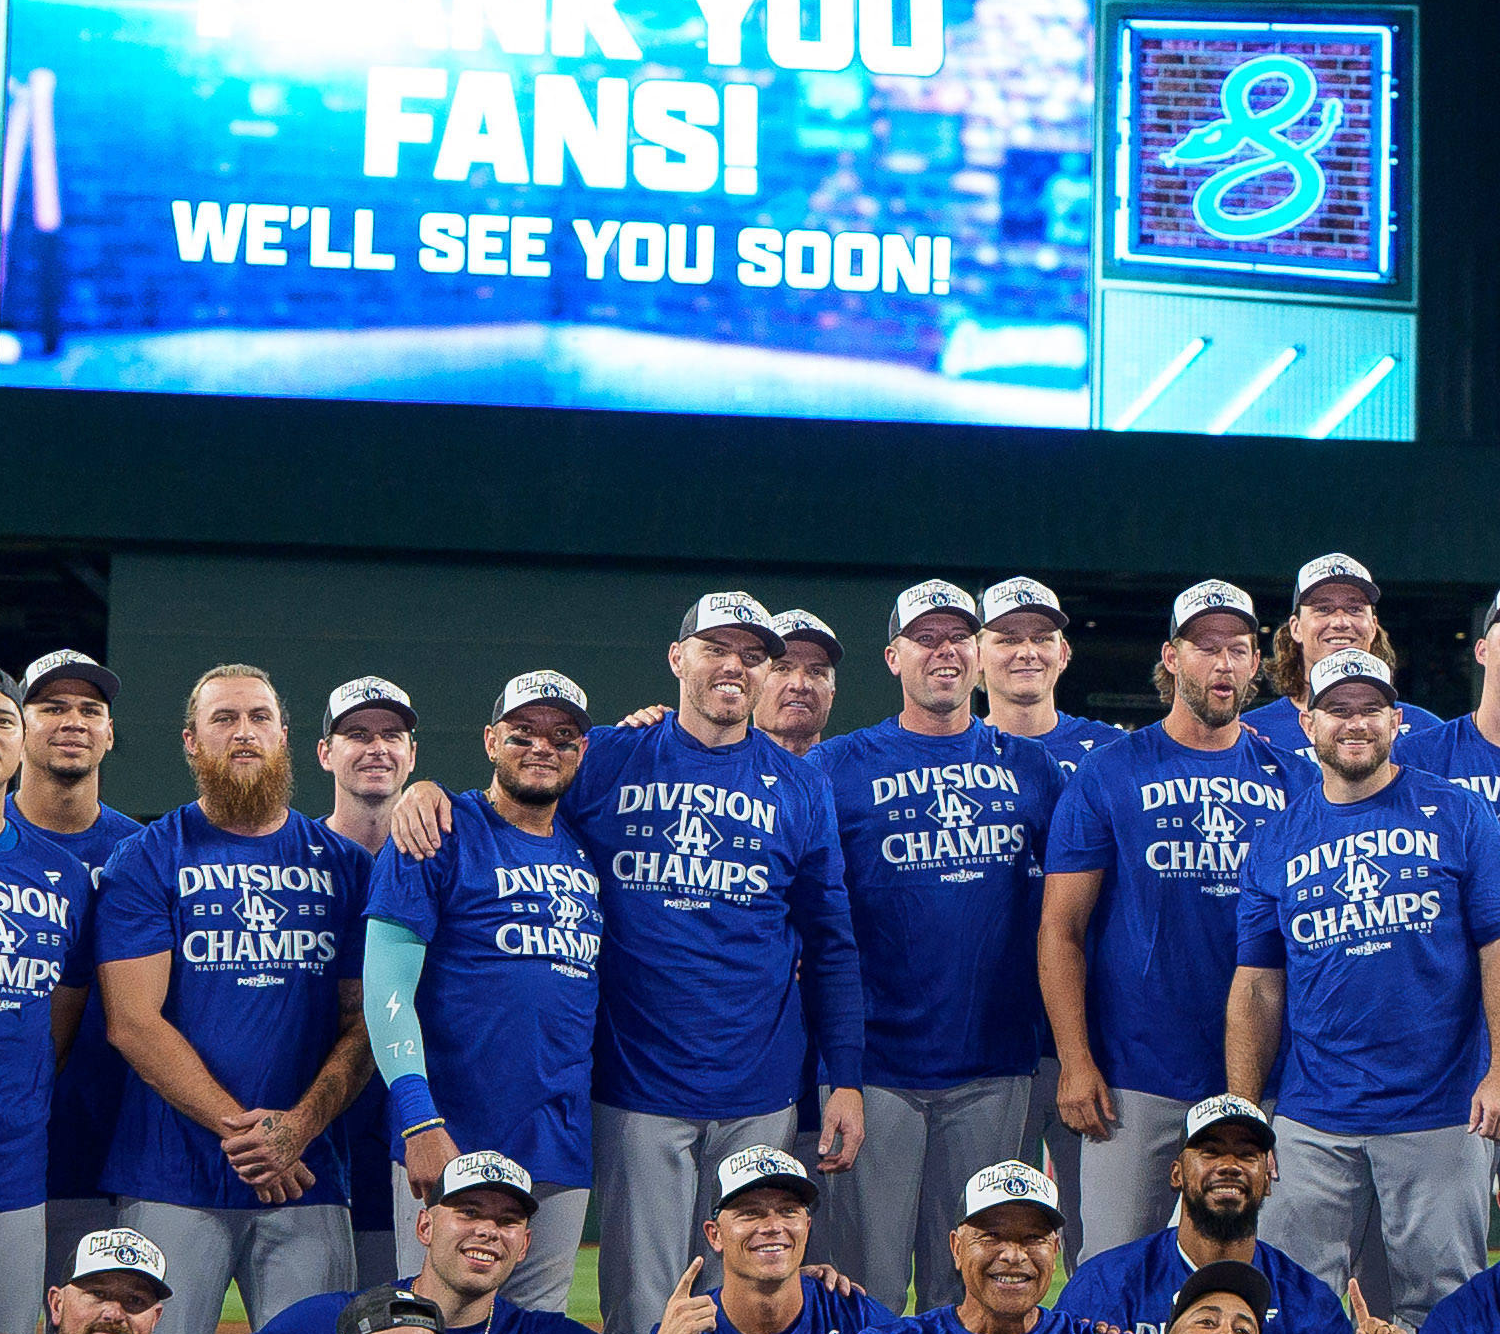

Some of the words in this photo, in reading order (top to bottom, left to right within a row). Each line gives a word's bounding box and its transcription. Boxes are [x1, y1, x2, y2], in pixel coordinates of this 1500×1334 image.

[361, 70, 760, 197] FANS!
[171, 201, 397, 275] WE'LL
[418, 215, 551, 279] SEE
[573, 221, 711, 288] YOU
[737, 229, 953, 297] SOON!
[872, 762, 1019, 808] DIVISION
[1140, 777, 1287, 812] DIVISION
[615, 782, 777, 836] DIVISION
[888, 808, 917, 822] 20
[991, 800, 1016, 813] 25
[624, 824, 654, 838] 20
[731, 836, 762, 851] 25
[880, 825, 1026, 865] CHAMPS
[611, 850, 770, 896] CHAMPS
[1285, 828, 1441, 889] DIVISION
[177, 863, 335, 897] DIVISION
[1295, 885, 1325, 902] 20
[1399, 866, 1429, 879] 25
[192, 903, 223, 917] 20
[296, 903, 327, 917] 25
[1290, 891, 1441, 943] CHAMPS
[181, 929, 336, 965] CHAMPS
